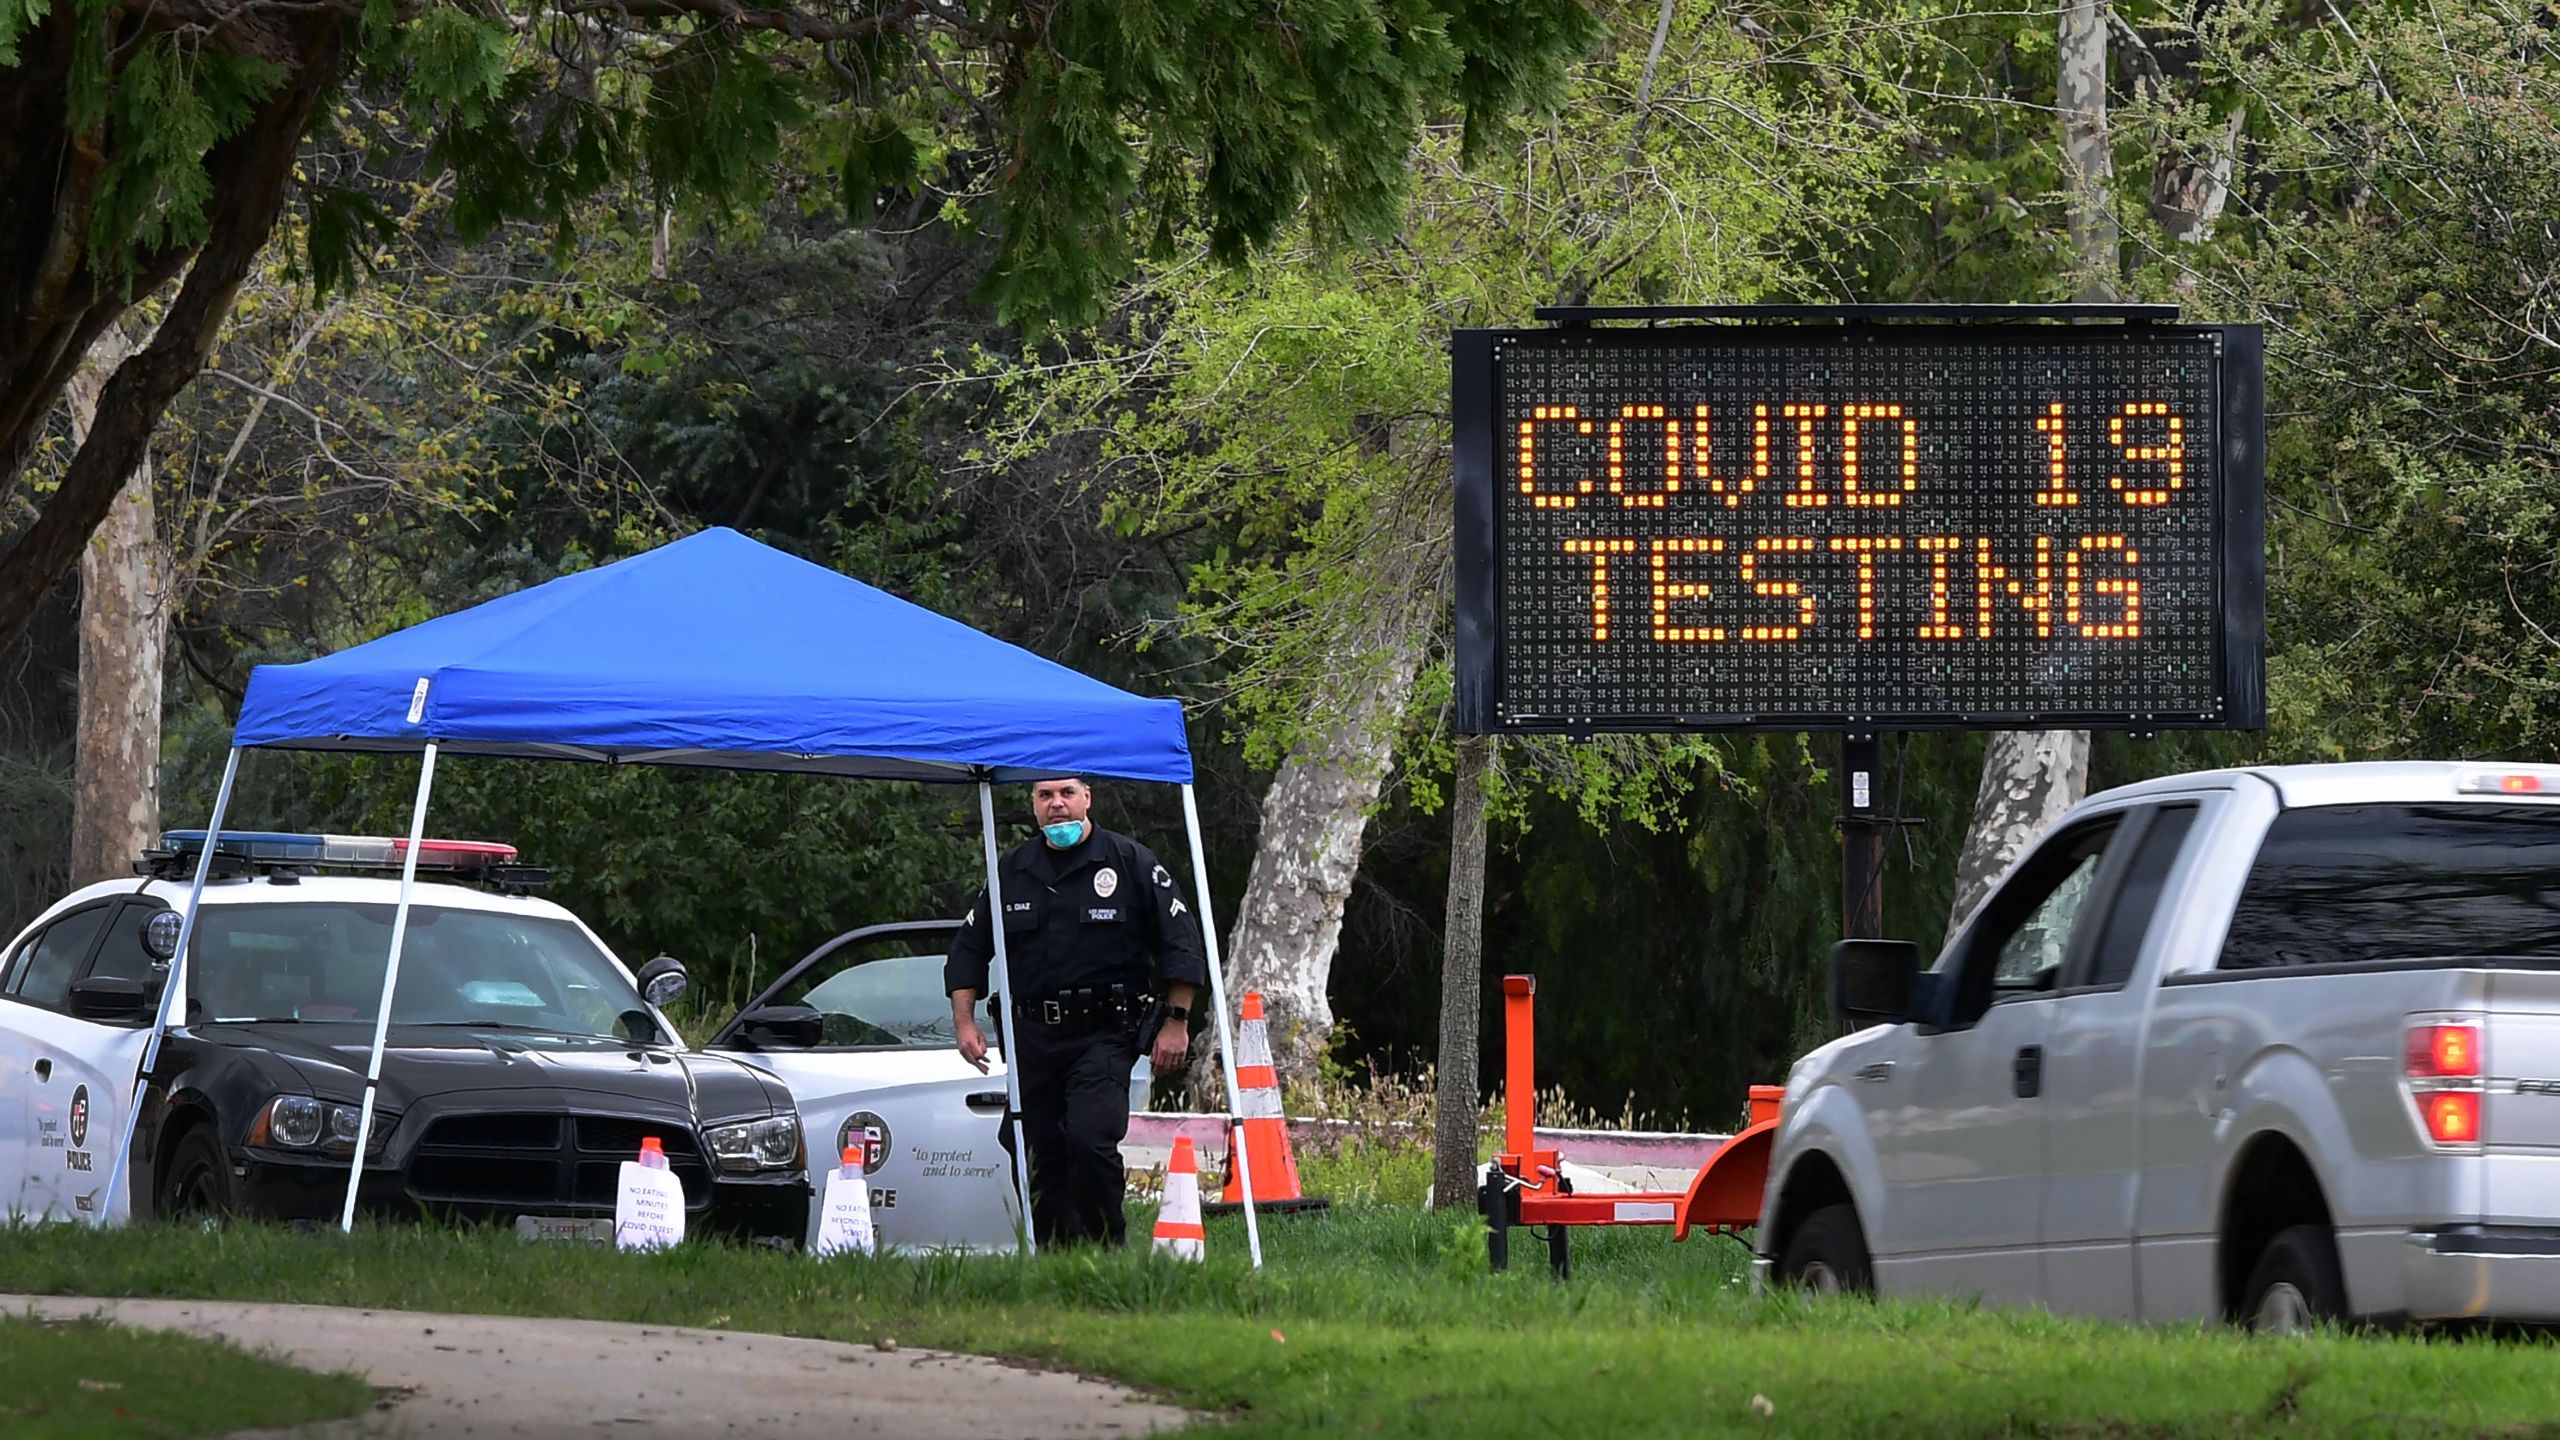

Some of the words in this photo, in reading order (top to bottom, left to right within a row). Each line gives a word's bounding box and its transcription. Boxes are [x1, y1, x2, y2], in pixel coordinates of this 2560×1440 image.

[1518, 404, 1916, 508] COVID
[2034, 402, 2183, 506] 19
[1563, 535, 2140, 641] TESTING
[1014, 903, 1031, 911] DIAZ
[66, 1149, 92, 1172] POLICE
[930, 1150, 972, 1164] protect
[922, 1164, 947, 1177] and
[949, 1165, 961, 1177] to
[629, 1187, 641, 1195] NO
[643, 1187, 668, 1198] EAT
[636, 1199, 668, 1210] MINUTES
[835, 1204, 847, 1212] NO
[637, 1210, 664, 1221] BEFORE
[831, 1217, 860, 1225] BEYOND
